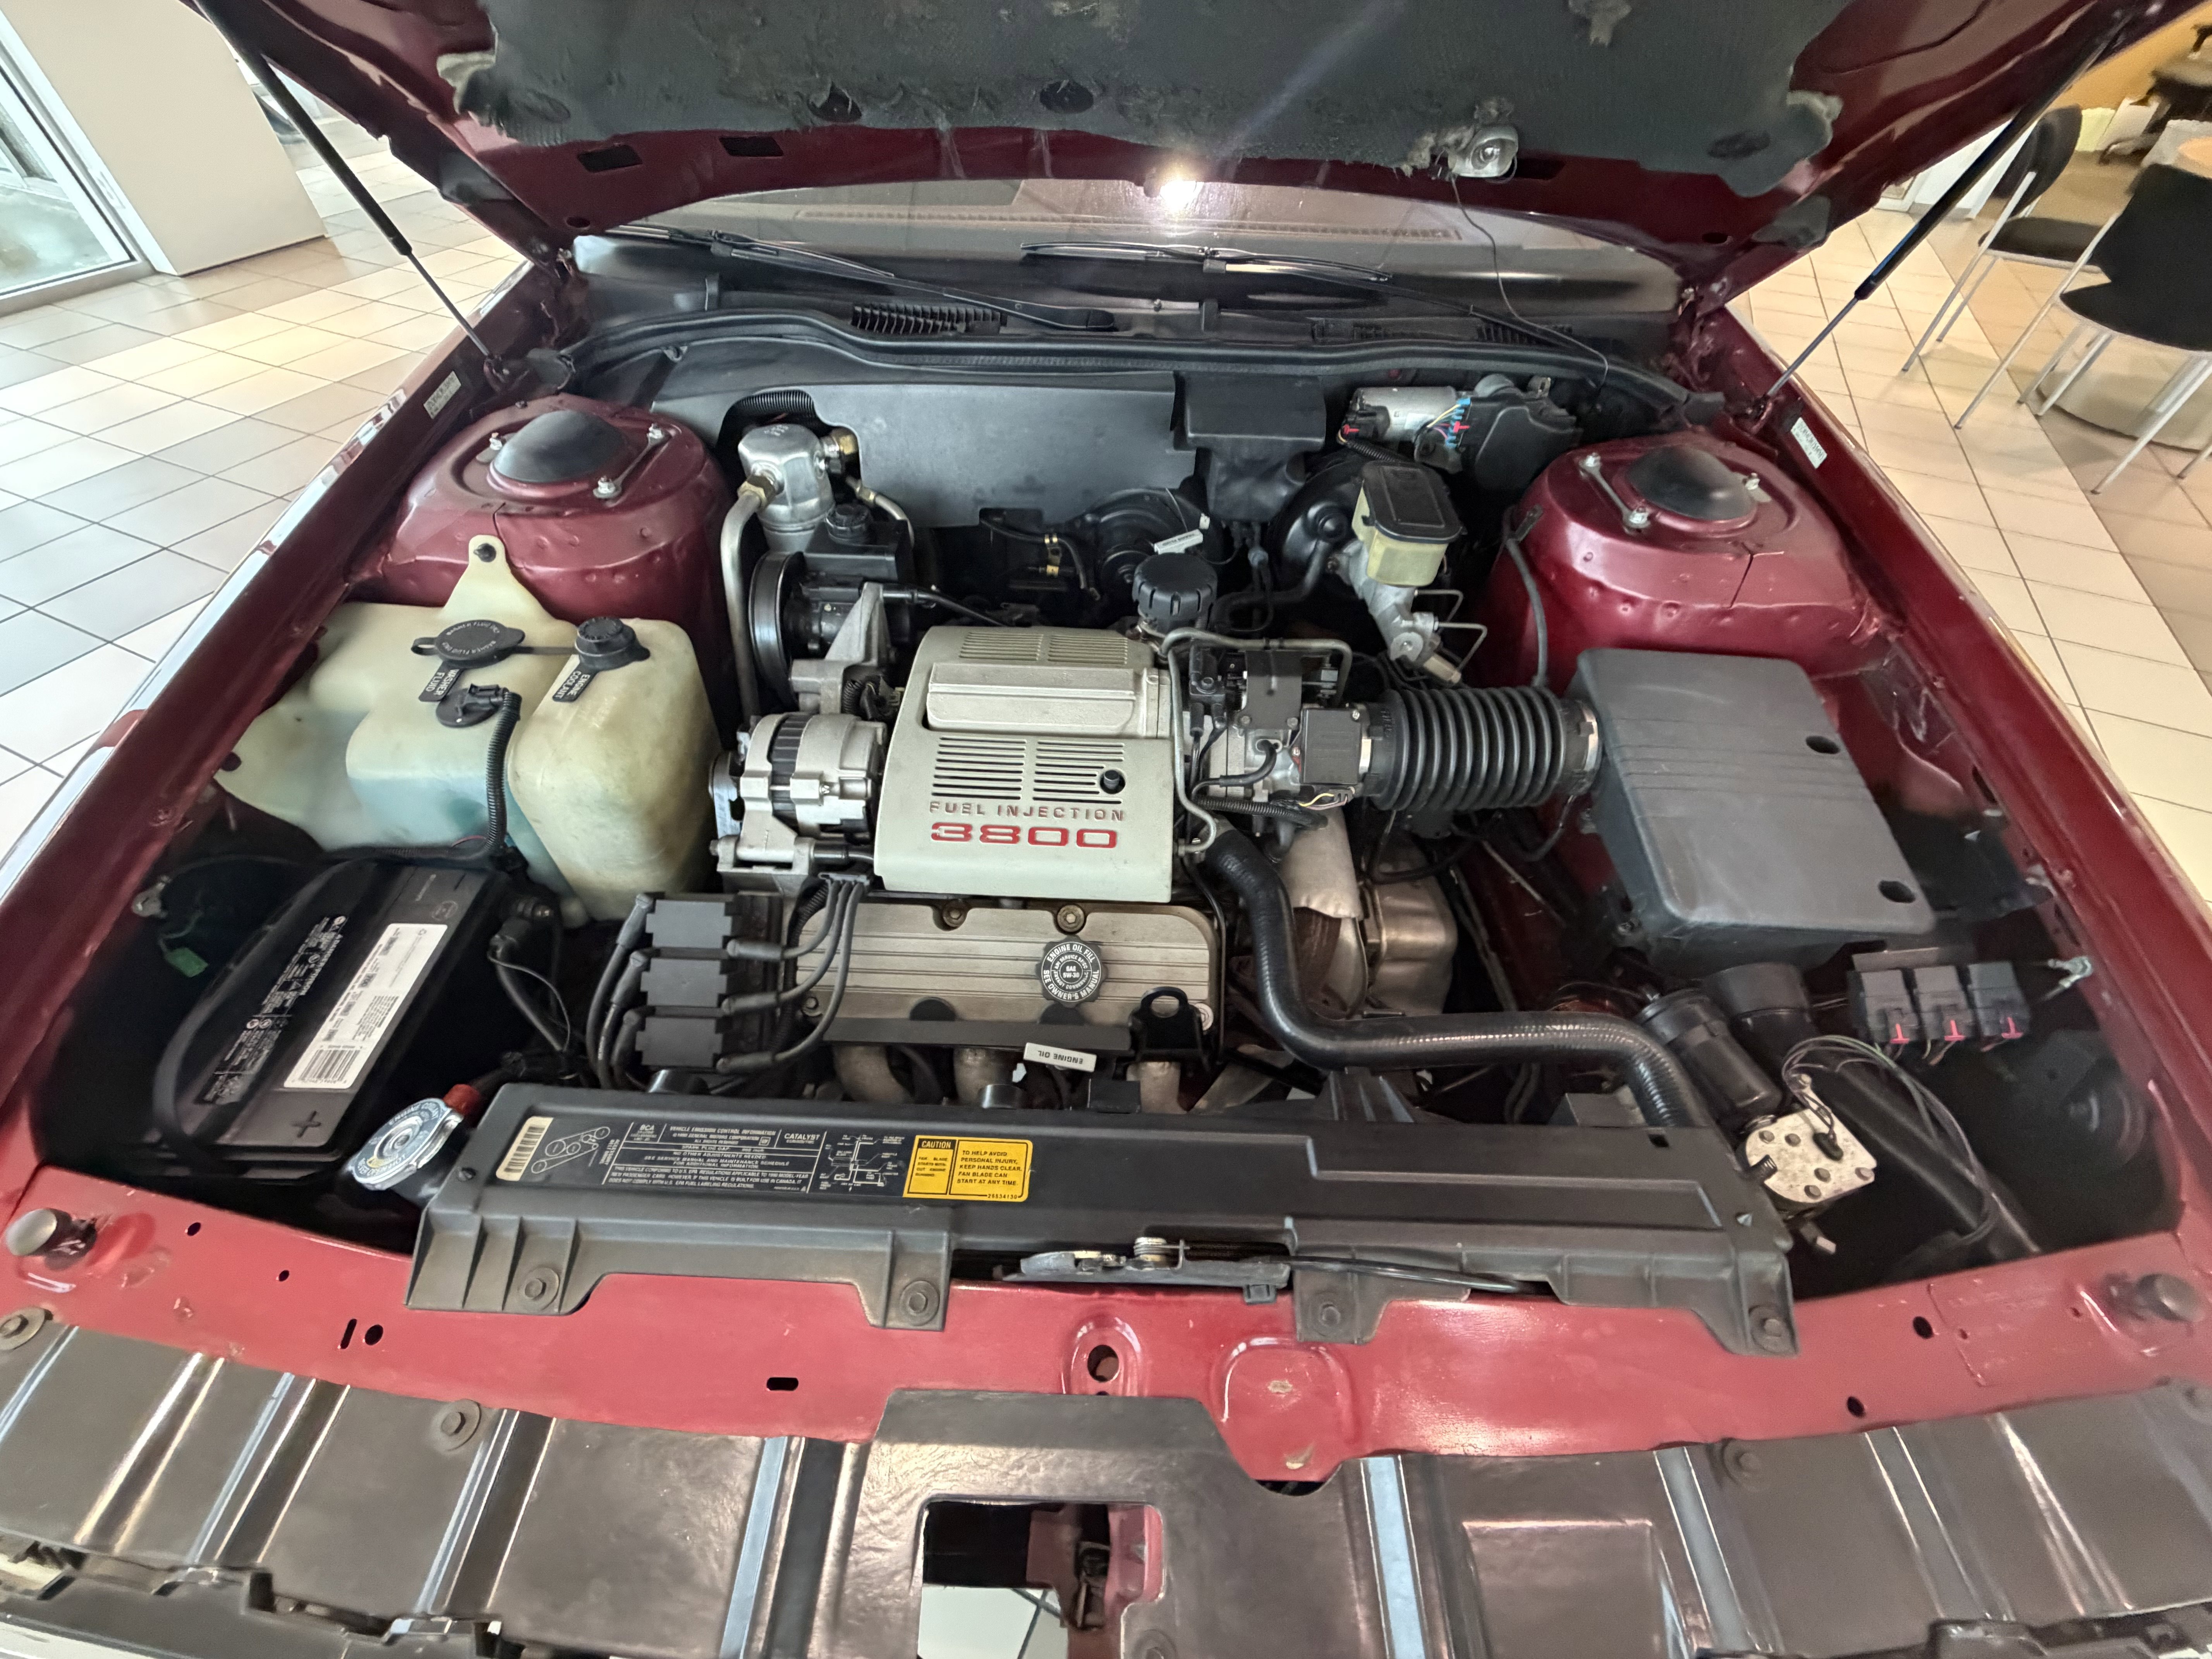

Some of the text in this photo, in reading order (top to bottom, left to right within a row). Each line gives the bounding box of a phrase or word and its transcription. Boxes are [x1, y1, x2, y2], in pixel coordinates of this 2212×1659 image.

[426, 672, 445, 692] FLUID
[433, 669, 459, 696] WASHER
[555, 671, 581, 698] COOLANT
[567, 674, 590, 696] ENGINE
[930, 801, 1123, 821] FUEL INJECTION
[931, 822, 1117, 848] 3800
[1047, 944, 1095, 963] ENGINE OIL FILL
[1048, 984, 1079, 1000] OWNER'S
[1080, 970, 1099, 998] MANUAL
[1053, 1053, 1083, 1064] ENGINE
[921, 1140, 951, 1149] CAUTION
